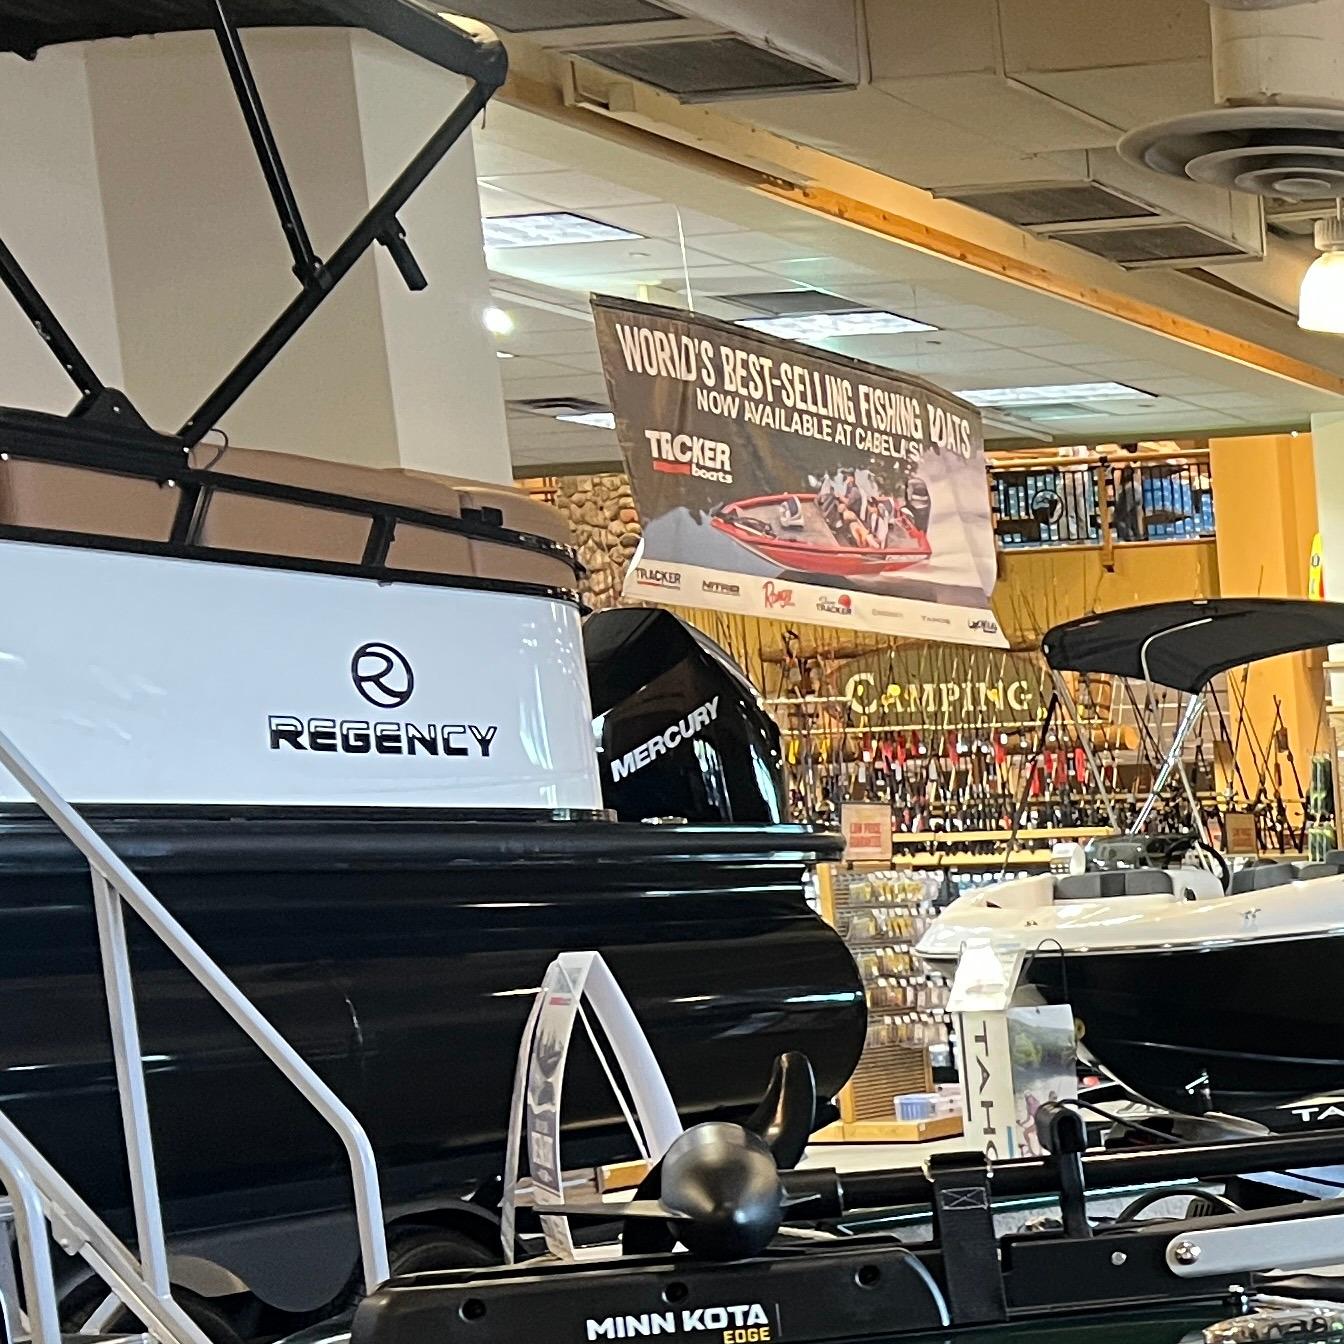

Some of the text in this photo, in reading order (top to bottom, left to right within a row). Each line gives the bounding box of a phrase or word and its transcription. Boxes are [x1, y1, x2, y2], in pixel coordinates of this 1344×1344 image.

[615, 323, 716, 387] WORLD'S
[720, 345, 857, 424] BEST-SELLING
[858, 384, 924, 440] FISHING
[696, 387, 739, 420] NOW
[744, 400, 832, 442] AVAILABLE
[835, 422, 853, 447] AT
[691, 462, 734, 484] boats
[267, 714, 498, 758] REGENCY
[609, 696, 721, 784] MERCURY
[586, 1303, 769, 1341] MINN KOTA
[723, 1326, 771, 1344] EDGE
